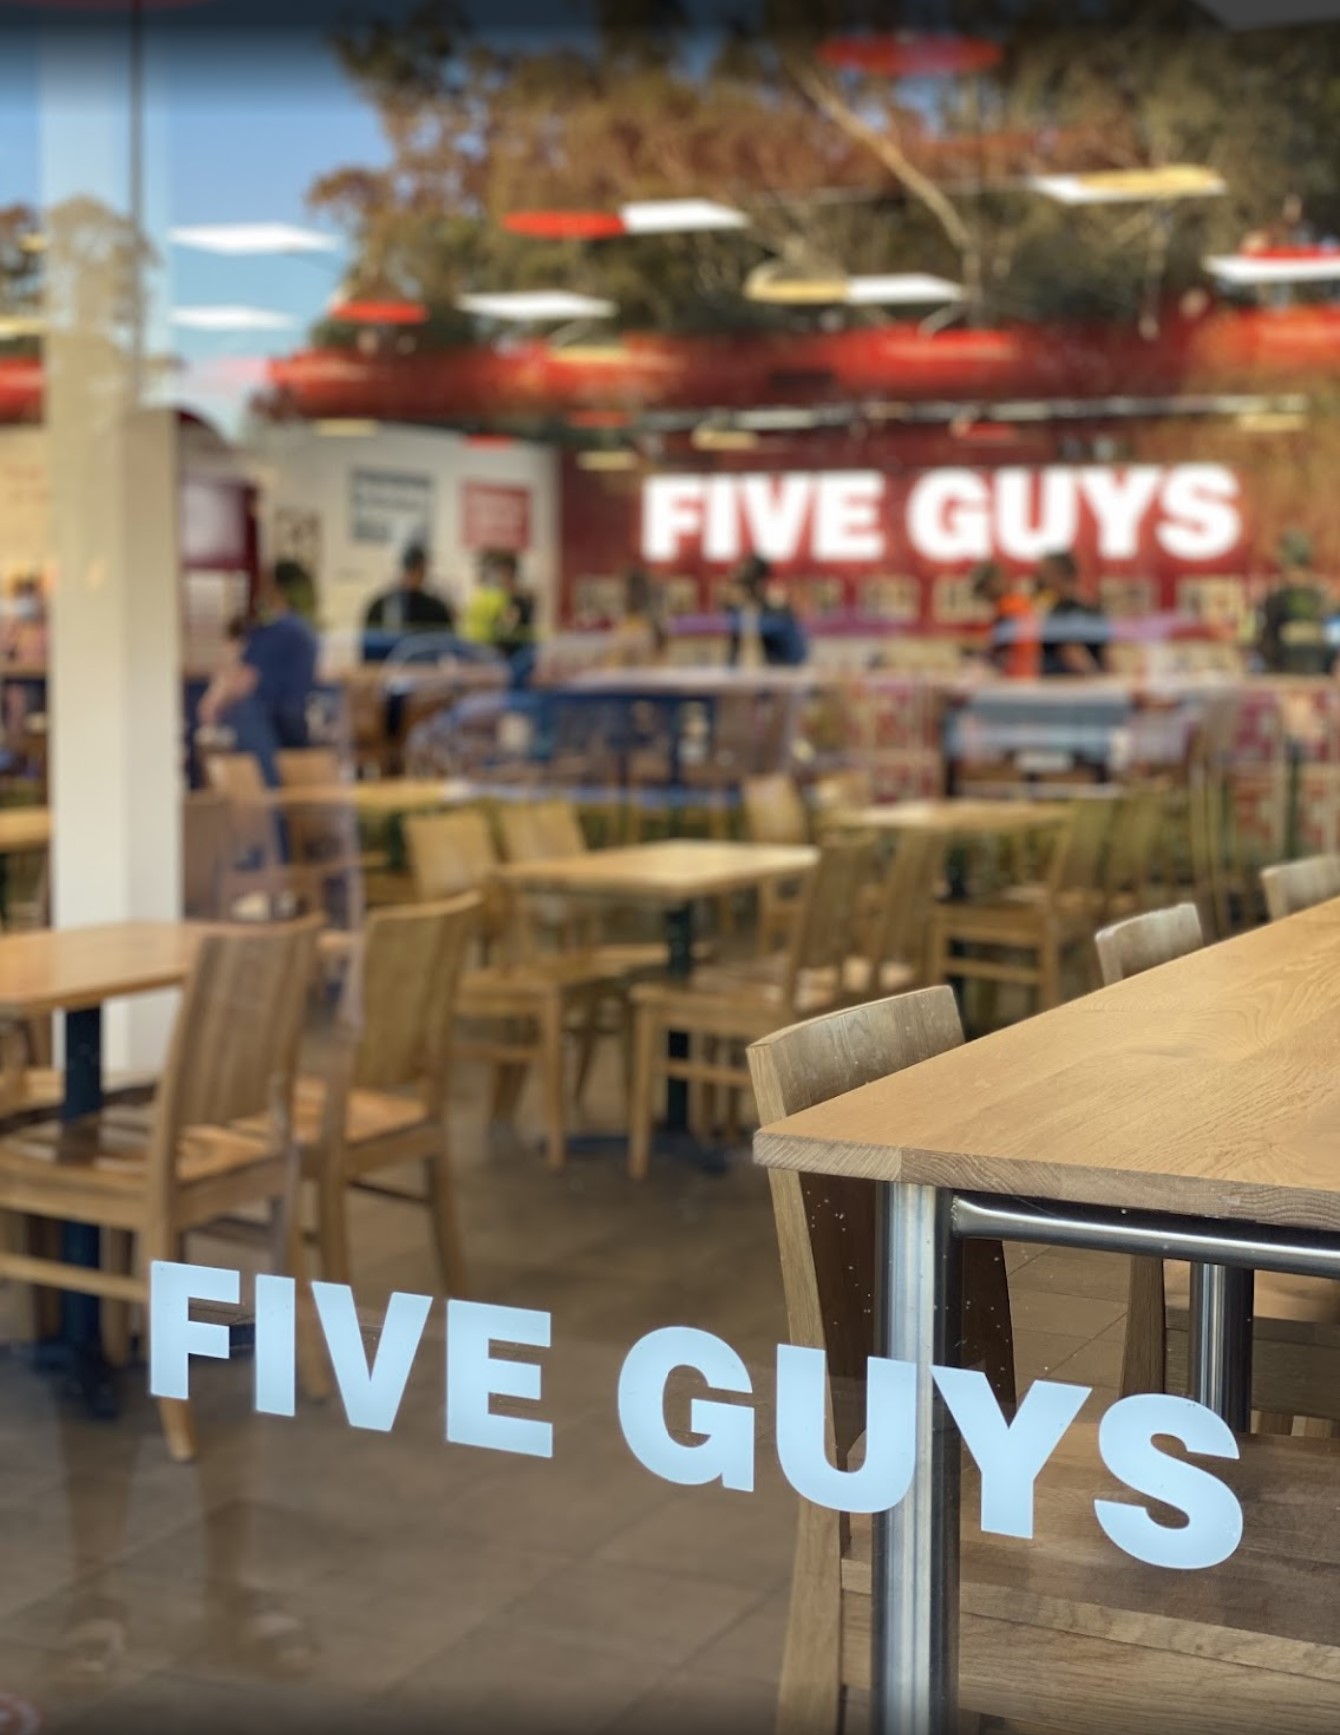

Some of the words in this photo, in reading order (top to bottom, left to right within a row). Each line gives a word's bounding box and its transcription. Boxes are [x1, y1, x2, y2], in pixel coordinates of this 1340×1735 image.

[642, 471, 885, 562] FIVE
[906, 463, 1241, 561] GUYS
[149, 1260, 553, 1458] FIVE
[618, 1326, 1244, 1570] GUYS
